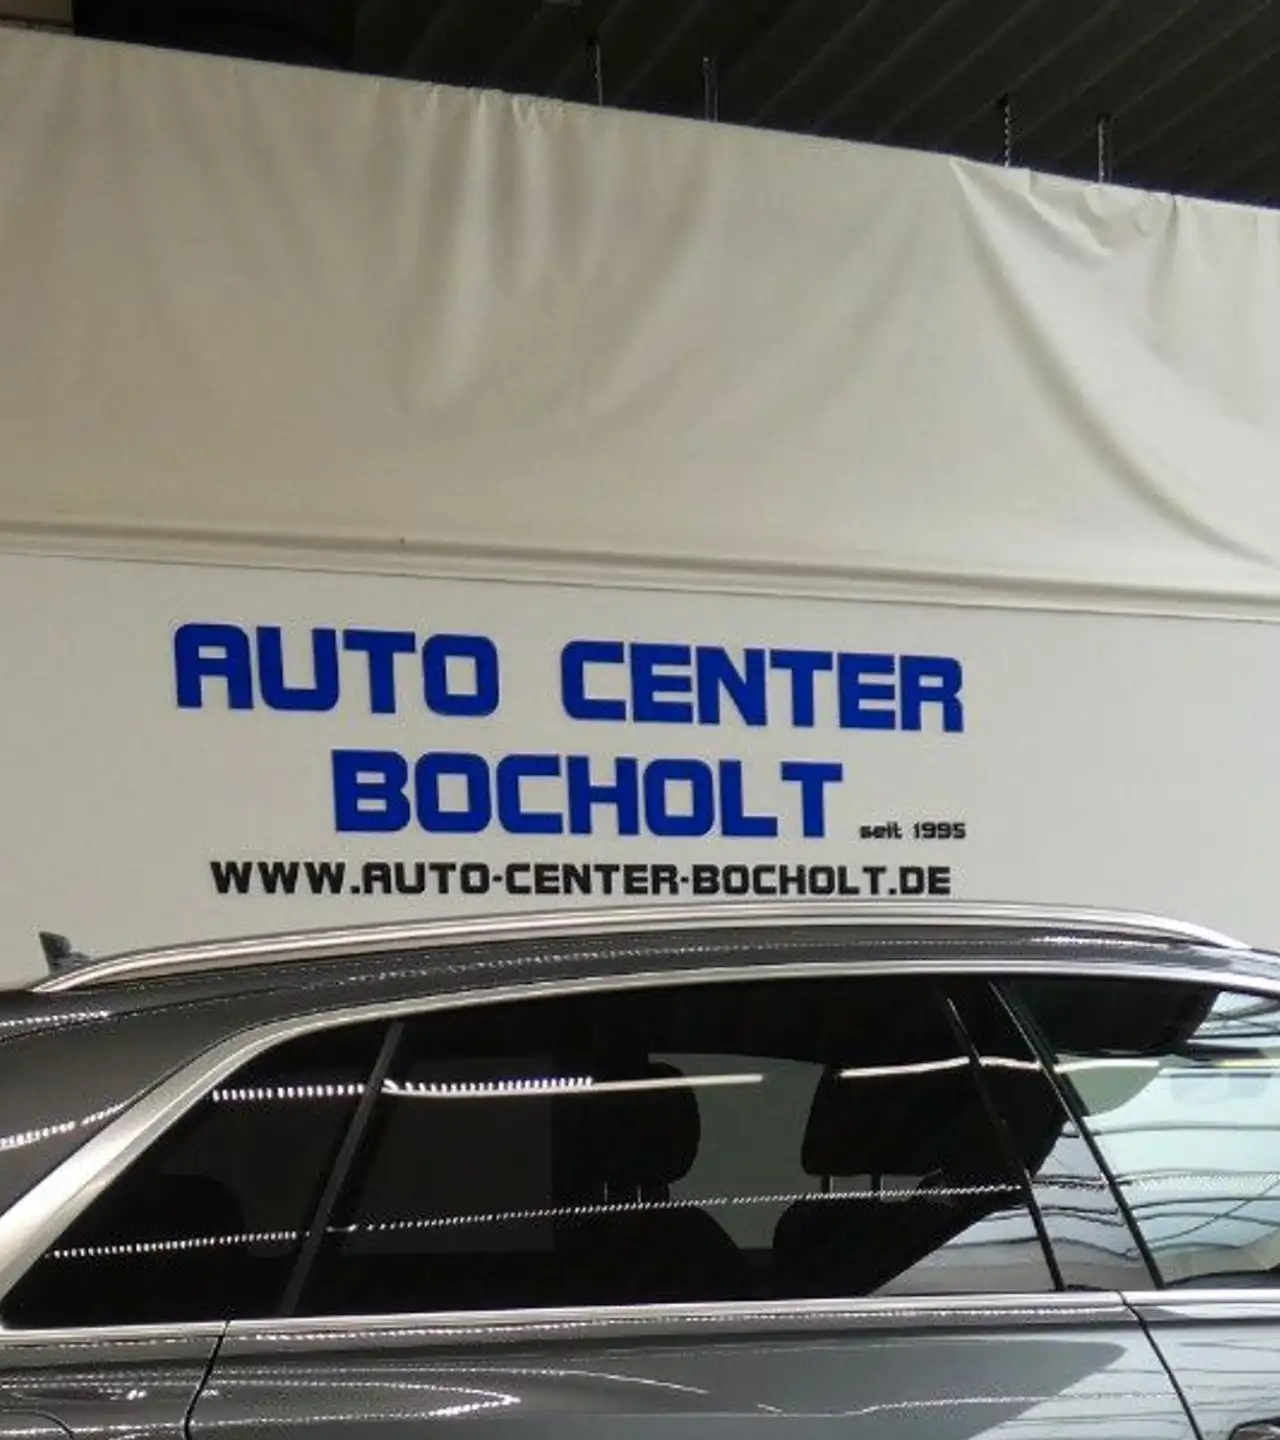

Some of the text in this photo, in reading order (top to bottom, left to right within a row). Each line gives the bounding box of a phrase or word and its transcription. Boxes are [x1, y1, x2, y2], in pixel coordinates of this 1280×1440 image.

[173, 622, 964, 733] AUTO CENTER
[331, 749, 967, 840] BOCHOLT seit 1995
[209, 860, 952, 896] WWW.AUTO-CENTER-BOCHOLT.DE
